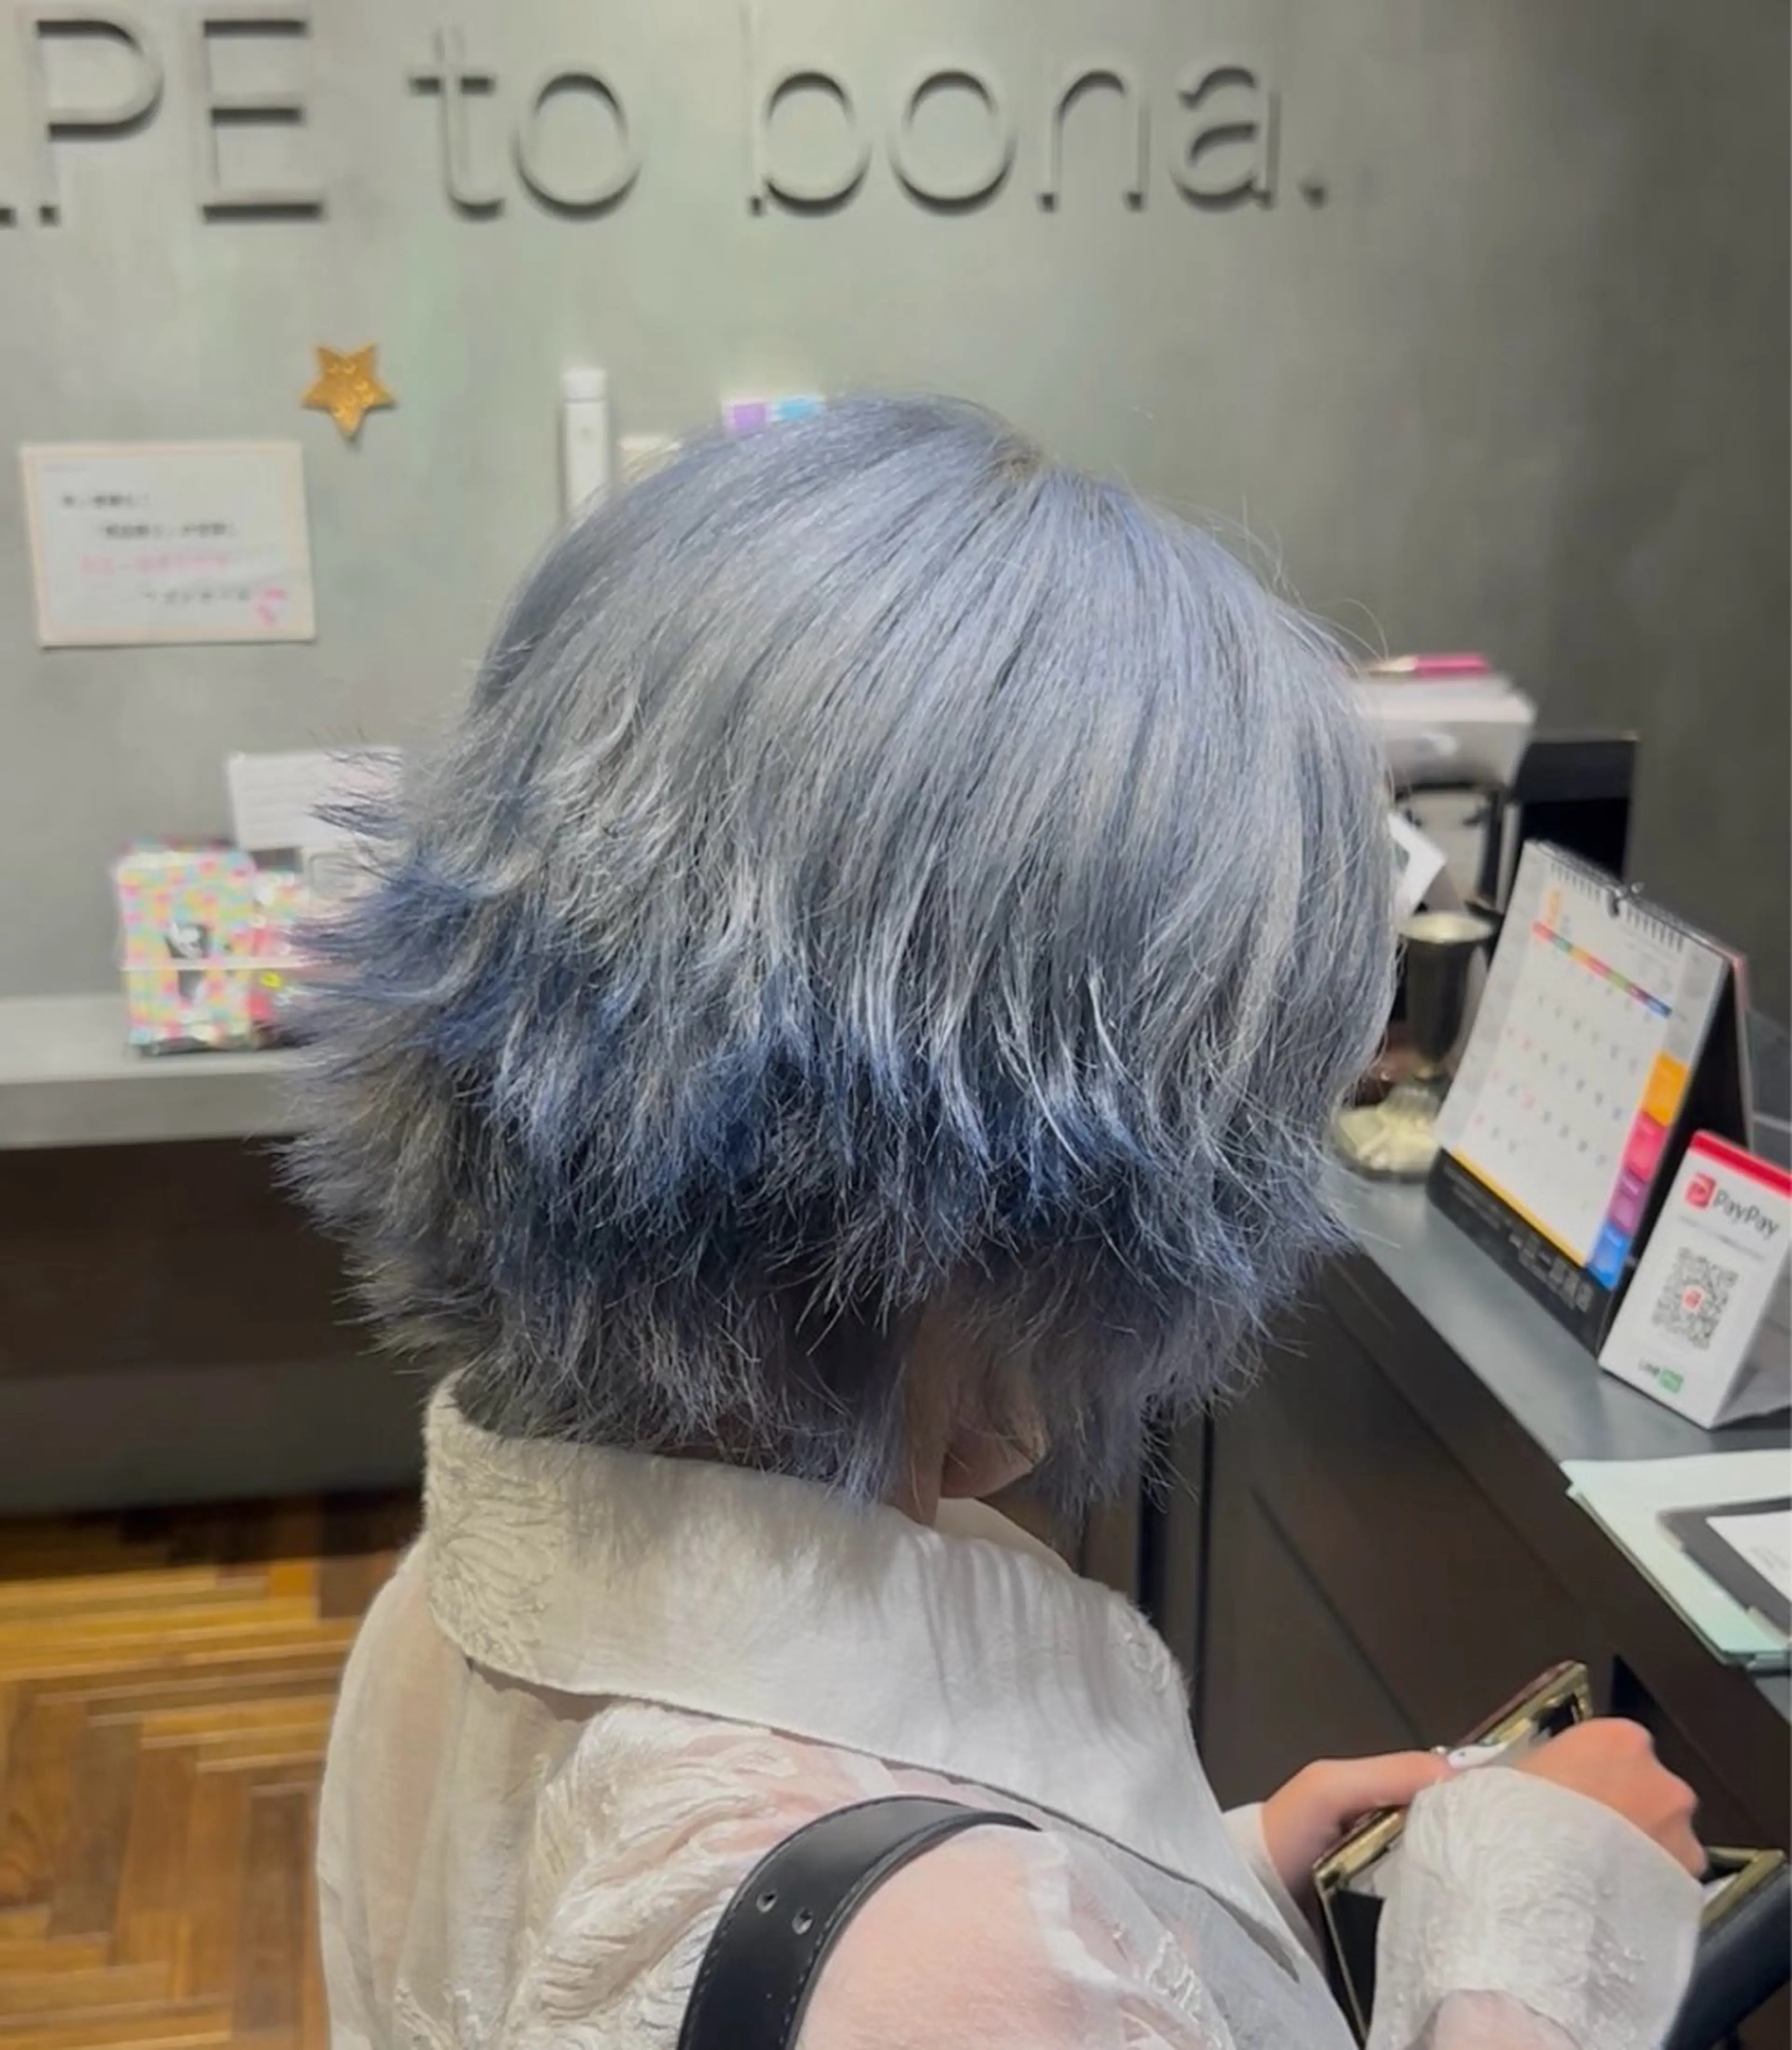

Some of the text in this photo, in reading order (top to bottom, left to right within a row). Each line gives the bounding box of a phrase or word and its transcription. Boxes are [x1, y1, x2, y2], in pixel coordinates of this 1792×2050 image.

[0, 5, 1331, 226] PE to bona.
[1713, 1189, 1780, 1241] PayPay
